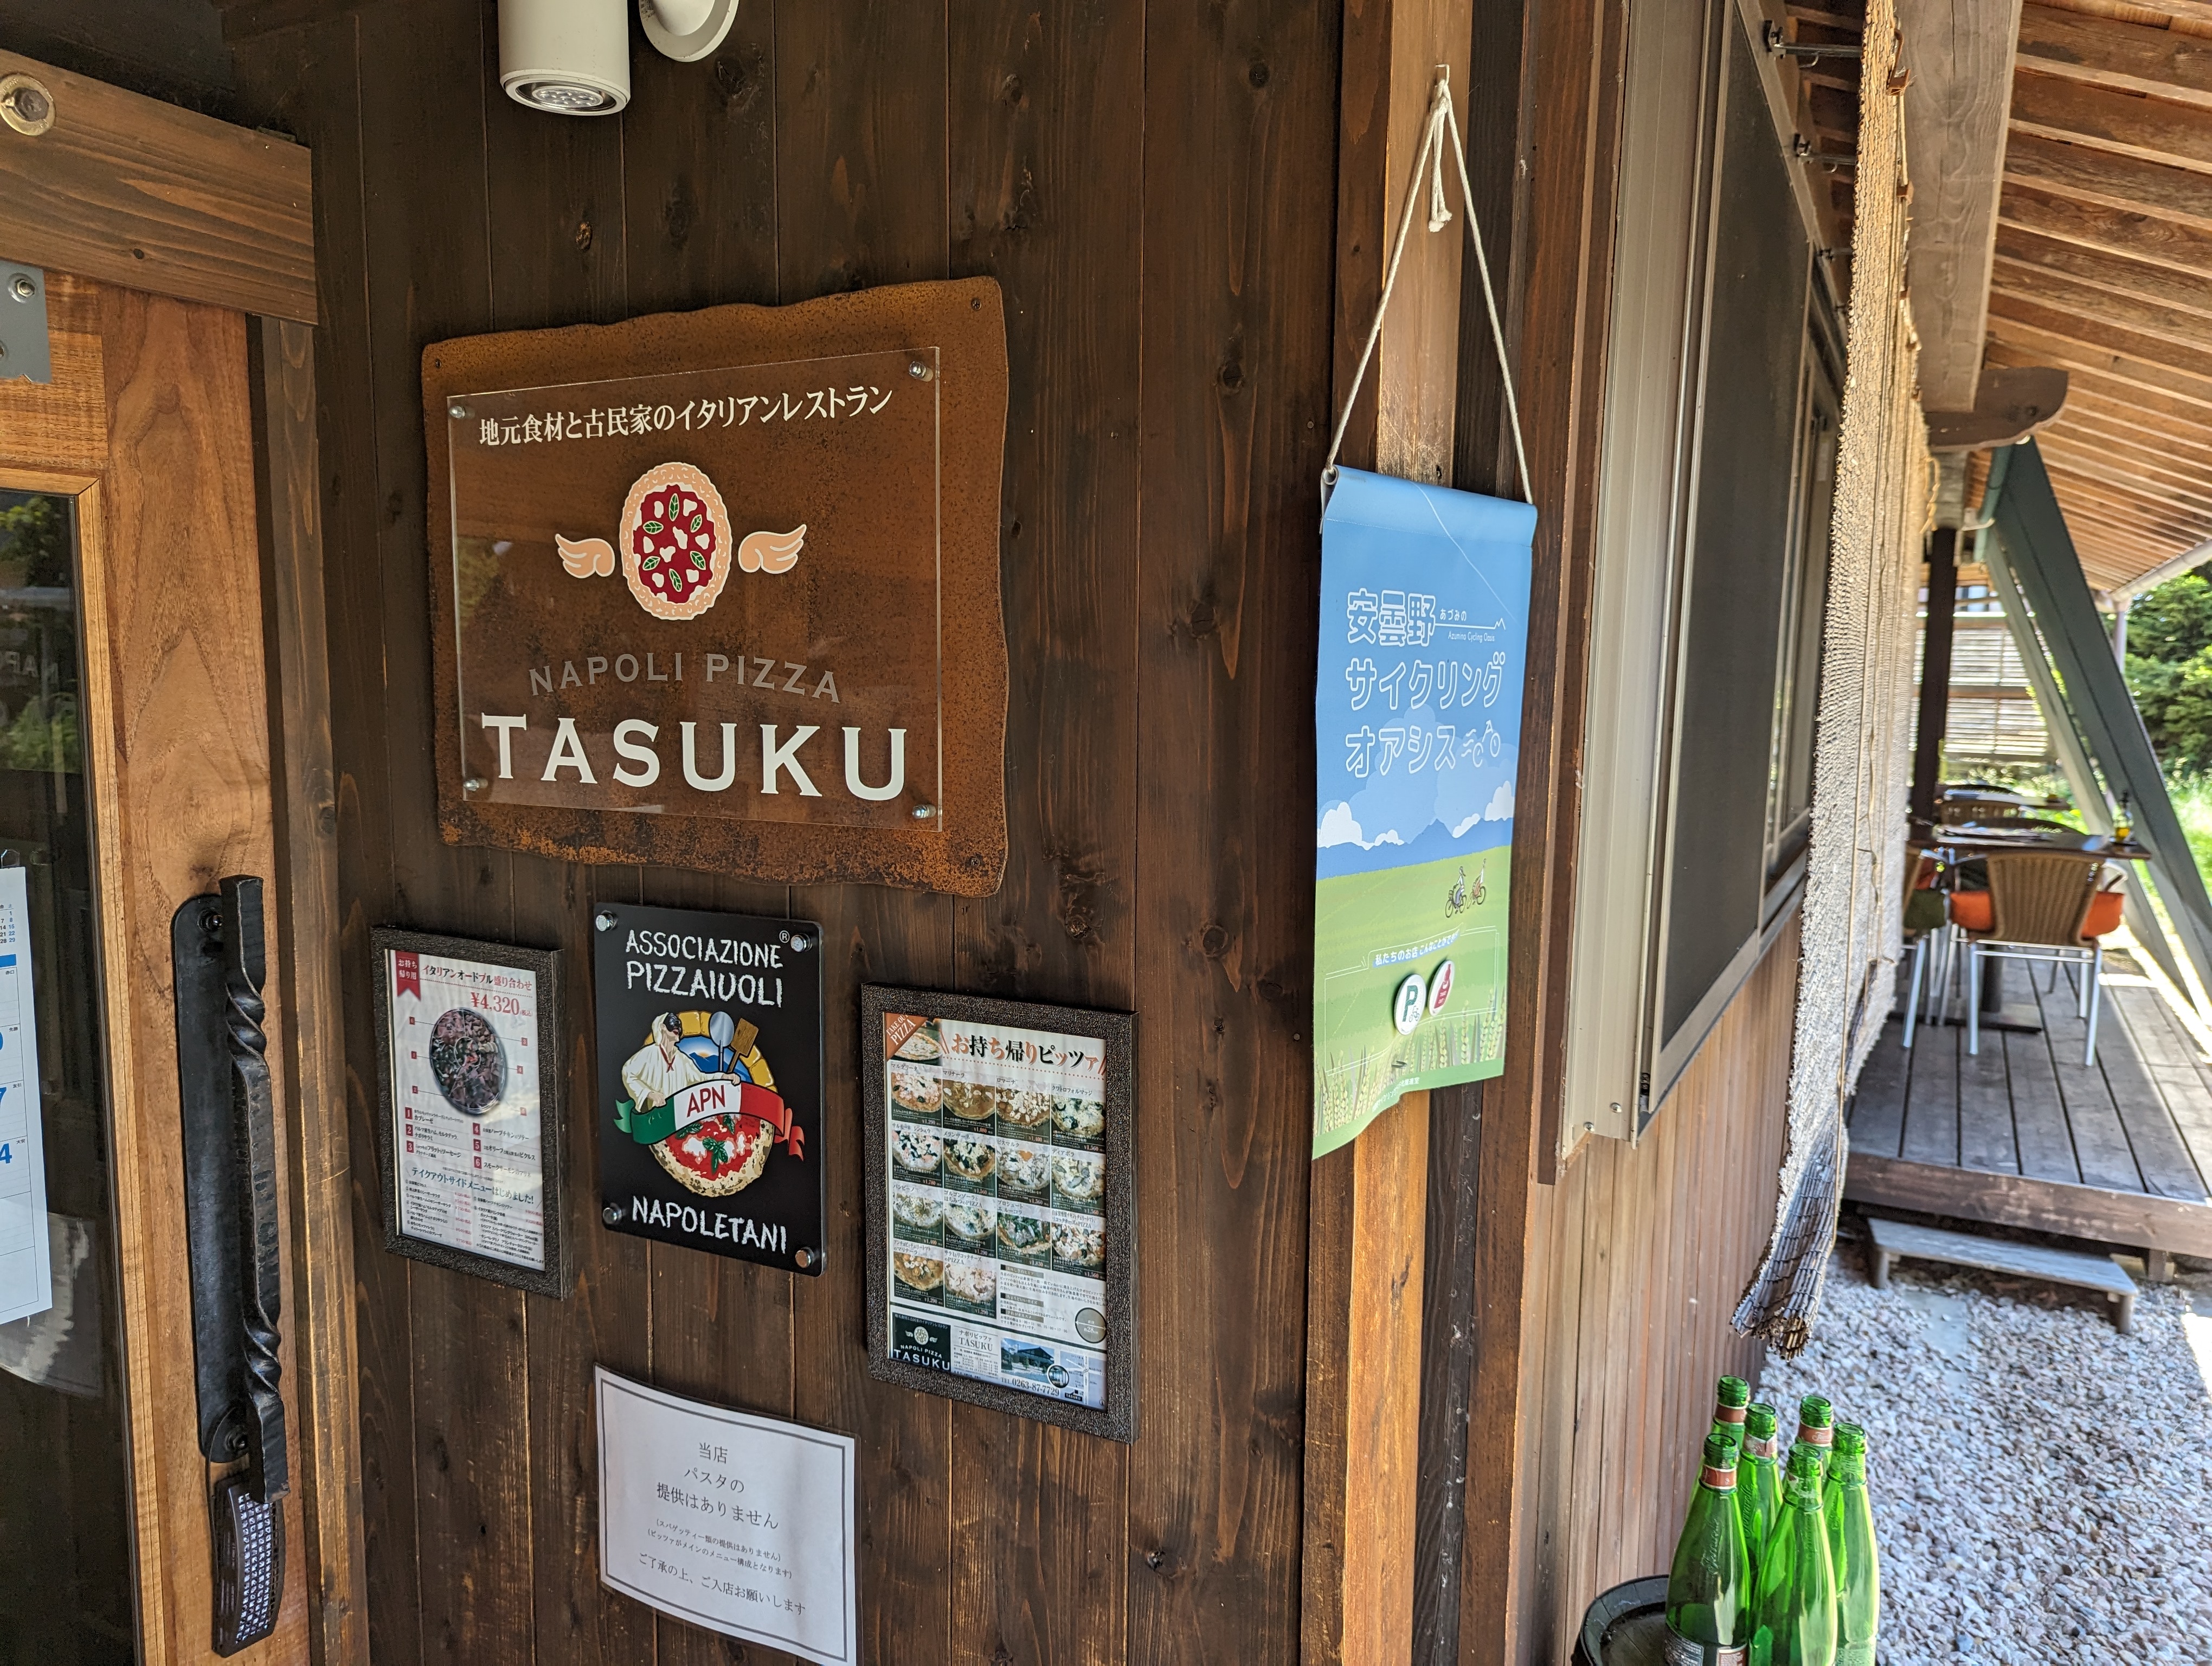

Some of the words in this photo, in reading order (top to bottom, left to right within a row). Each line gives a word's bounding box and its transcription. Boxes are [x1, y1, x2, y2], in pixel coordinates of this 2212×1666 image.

[479, 387, 892, 446] 地元食材と古民家のイタリアンレストラン
[1347, 588, 1436, 647] 安曇野
[1439, 608, 1467, 621] あづみの
[1448, 631, 1466, 640] Azumino
[1468, 632, 1482, 643] Cycling
[1483, 633, 1495, 642] Oasis
[529, 652, 683, 696] NAPOLI
[706, 653, 840, 703] PIZZA
[1346, 651, 1506, 711] サイクリング
[481, 713, 906, 800] TASUKU
[1345, 725, 1456, 778] オアシス
[626, 929, 783, 969] ASSOCIAZIONE
[1375, 946, 1418, 966] 私たちのお店
[398, 958, 417, 969] お持ち
[398, 970, 417, 981] 帰り用
[422, 965, 532, 991] イタリアンオードブル盛り合わせ
[627, 961, 782, 1008] PIZZAIUOLI
[471, 992, 520, 1015] ¥4,320
[1402, 985, 1418, 1022] P
[886, 1021, 899, 1035] TAKE
[890, 1019, 916, 1046] PIZZA
[951, 1033, 1099, 1071] お持ち帰りピッツァ
[687, 1085, 726, 1118] APN
[997, 1139, 1020, 1148] ビスマルク
[1052, 1148, 1075, 1157] ディアボラ
[632, 1196, 786, 1254] NAPOLETANI
[959, 1329, 992, 1342] ナポリピッツァ
[959, 1337, 993, 1351] TASUKU
[893, 1349, 950, 1370] TASUKU
[924, 1348, 942, 1359] PIZZA
[1012, 1378, 1060, 1396] 0263-87-7729
[699, 1442, 728, 1464] 当店
[684, 1467, 745, 1493] パスタの
[656, 1482, 779, 1529] 提供はありません
